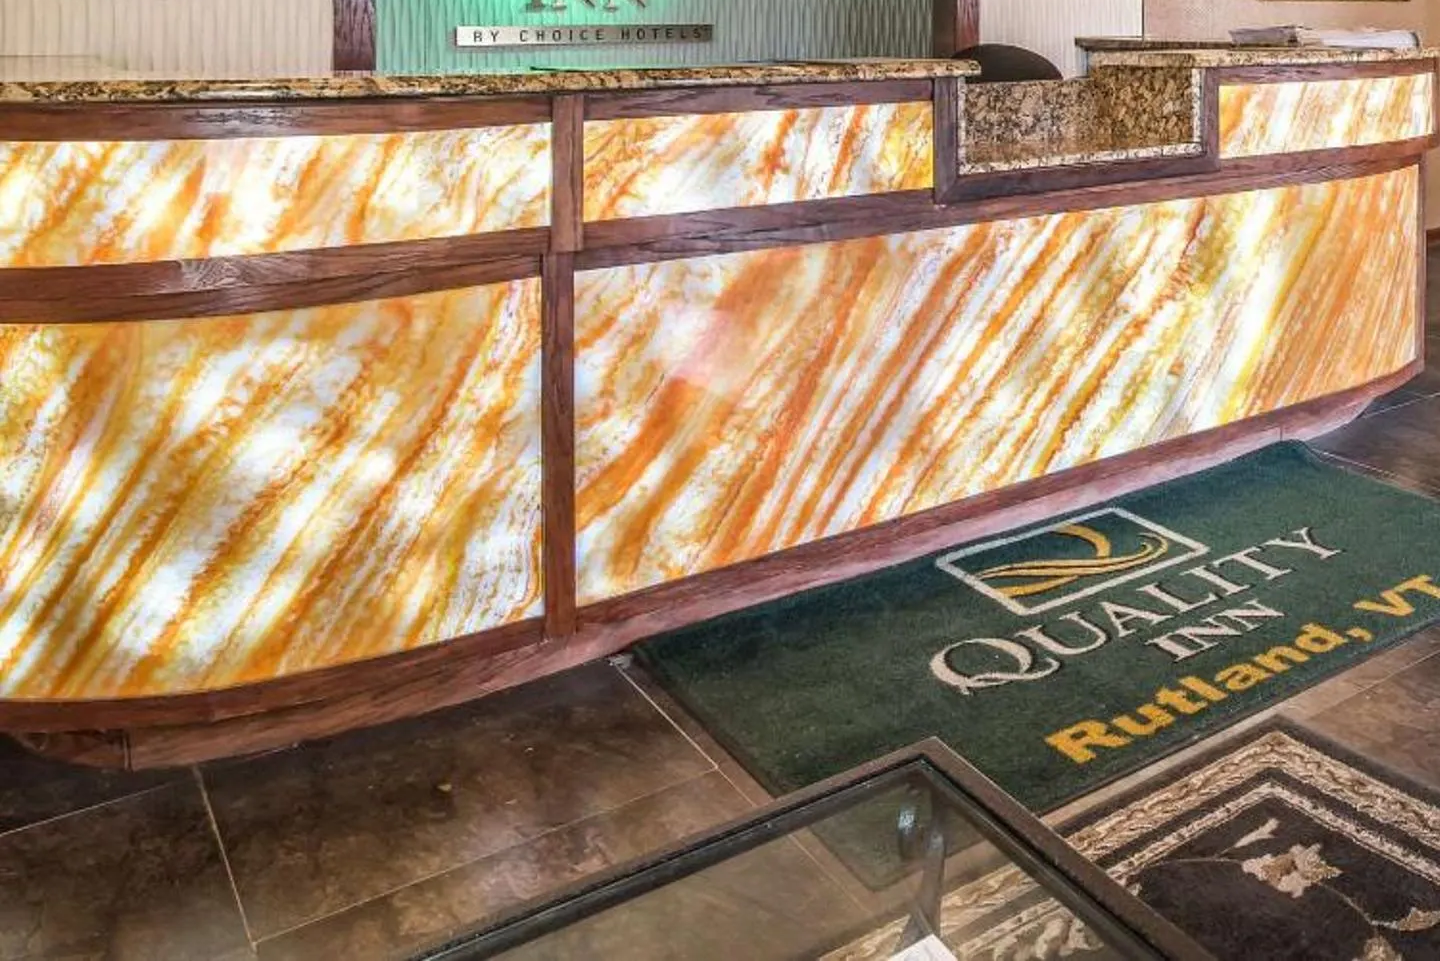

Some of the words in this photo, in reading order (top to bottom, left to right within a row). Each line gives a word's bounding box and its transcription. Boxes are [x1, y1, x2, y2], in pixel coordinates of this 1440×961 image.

[472, 29, 501, 43] BY
[518, 28, 605, 42] CHOICE
[620, 27, 702, 41] HOTELS
[929, 525, 1344, 697] QUALITY
[1149, 599, 1285, 664] INN
[1044, 620, 1374, 766] Rutland,
